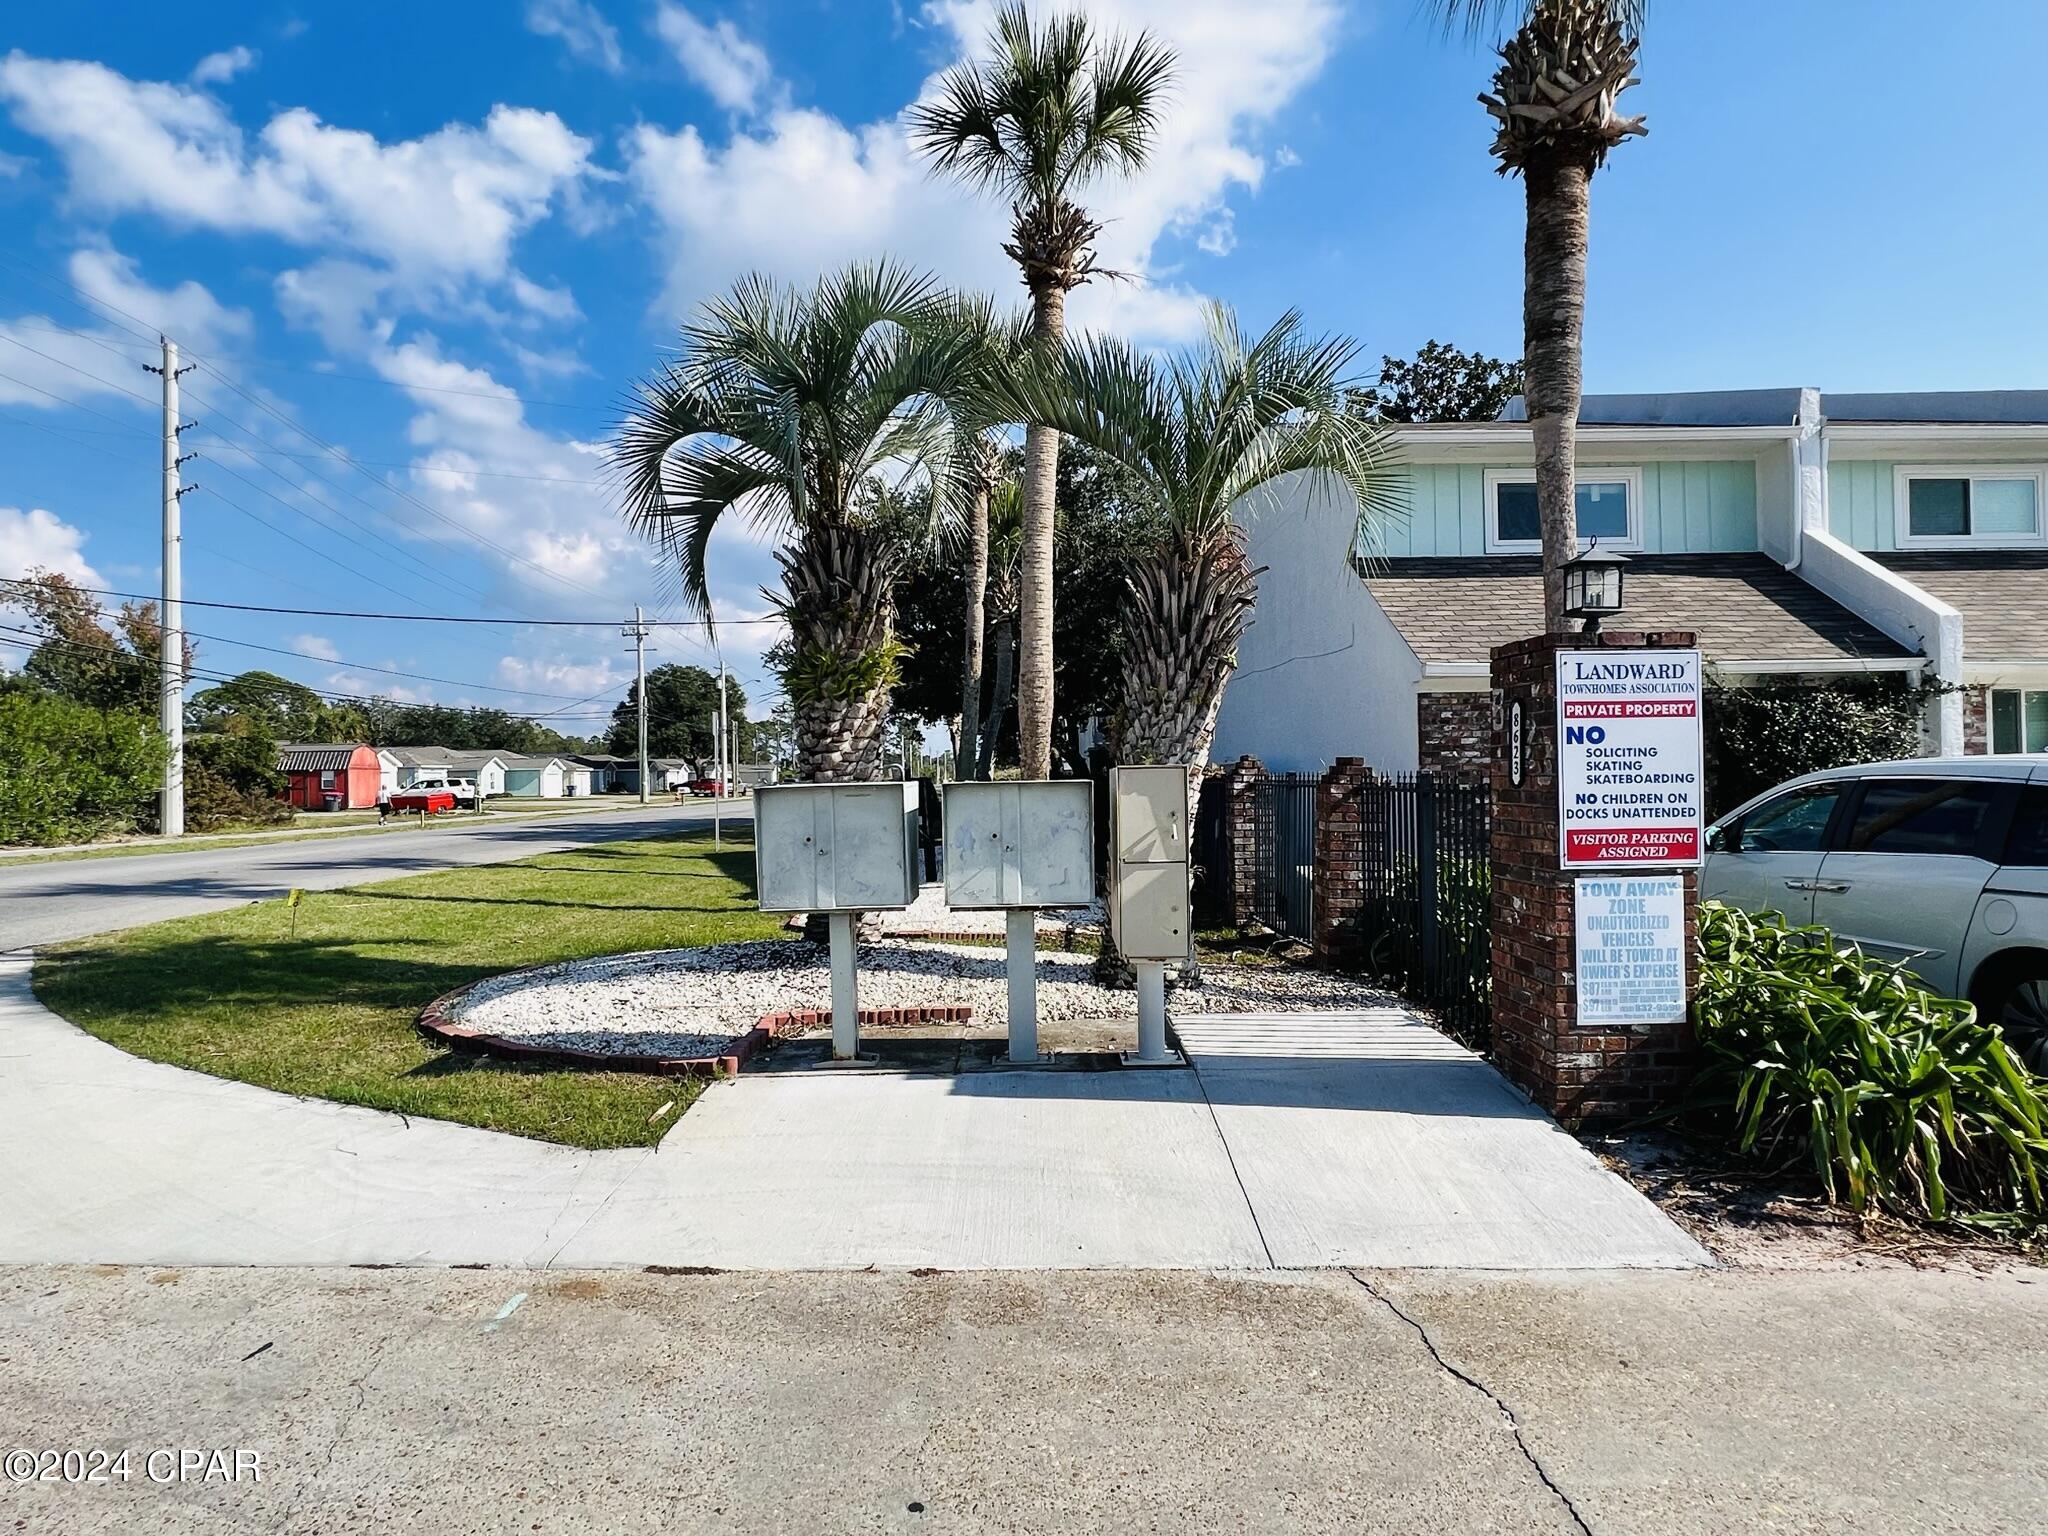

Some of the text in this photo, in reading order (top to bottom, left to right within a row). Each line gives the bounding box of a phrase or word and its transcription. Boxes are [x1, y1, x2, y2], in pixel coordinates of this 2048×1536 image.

[1575, 662, 1685, 680] LANDWARD
[1563, 682, 1695, 694] TOWNHOMES ASSOCIATION
[1566, 703, 1693, 716] PRIVATE PROPERTY
[1566, 726, 1605, 744] NO
[1586, 747, 1658, 758] SOLICITING
[1586, 761, 1643, 771] SKATING
[1586, 773, 1695, 784] SKATEBOARDING
[1576, 793, 1688, 804] NO CHILDREN ON
[1566, 807, 1696, 819] DOCKS UNATTENDED
[1572, 832, 1694, 845] VISITOR PARKING
[1597, 846, 1669, 858] ASSIGNED
[1580, 882, 1678, 897] TOW AWAY
[1608, 898, 1646, 914] ZONE
[1587, 915, 1669, 930] UNAUTHORIZED
[1601, 932, 1655, 947] VEHICLES
[1580, 947, 1678, 963] WILL BE TOWED AT
[1581, 964, 1679, 979] OWNER'S EXPENSE
[1582, 981, 1599, 996] $87
